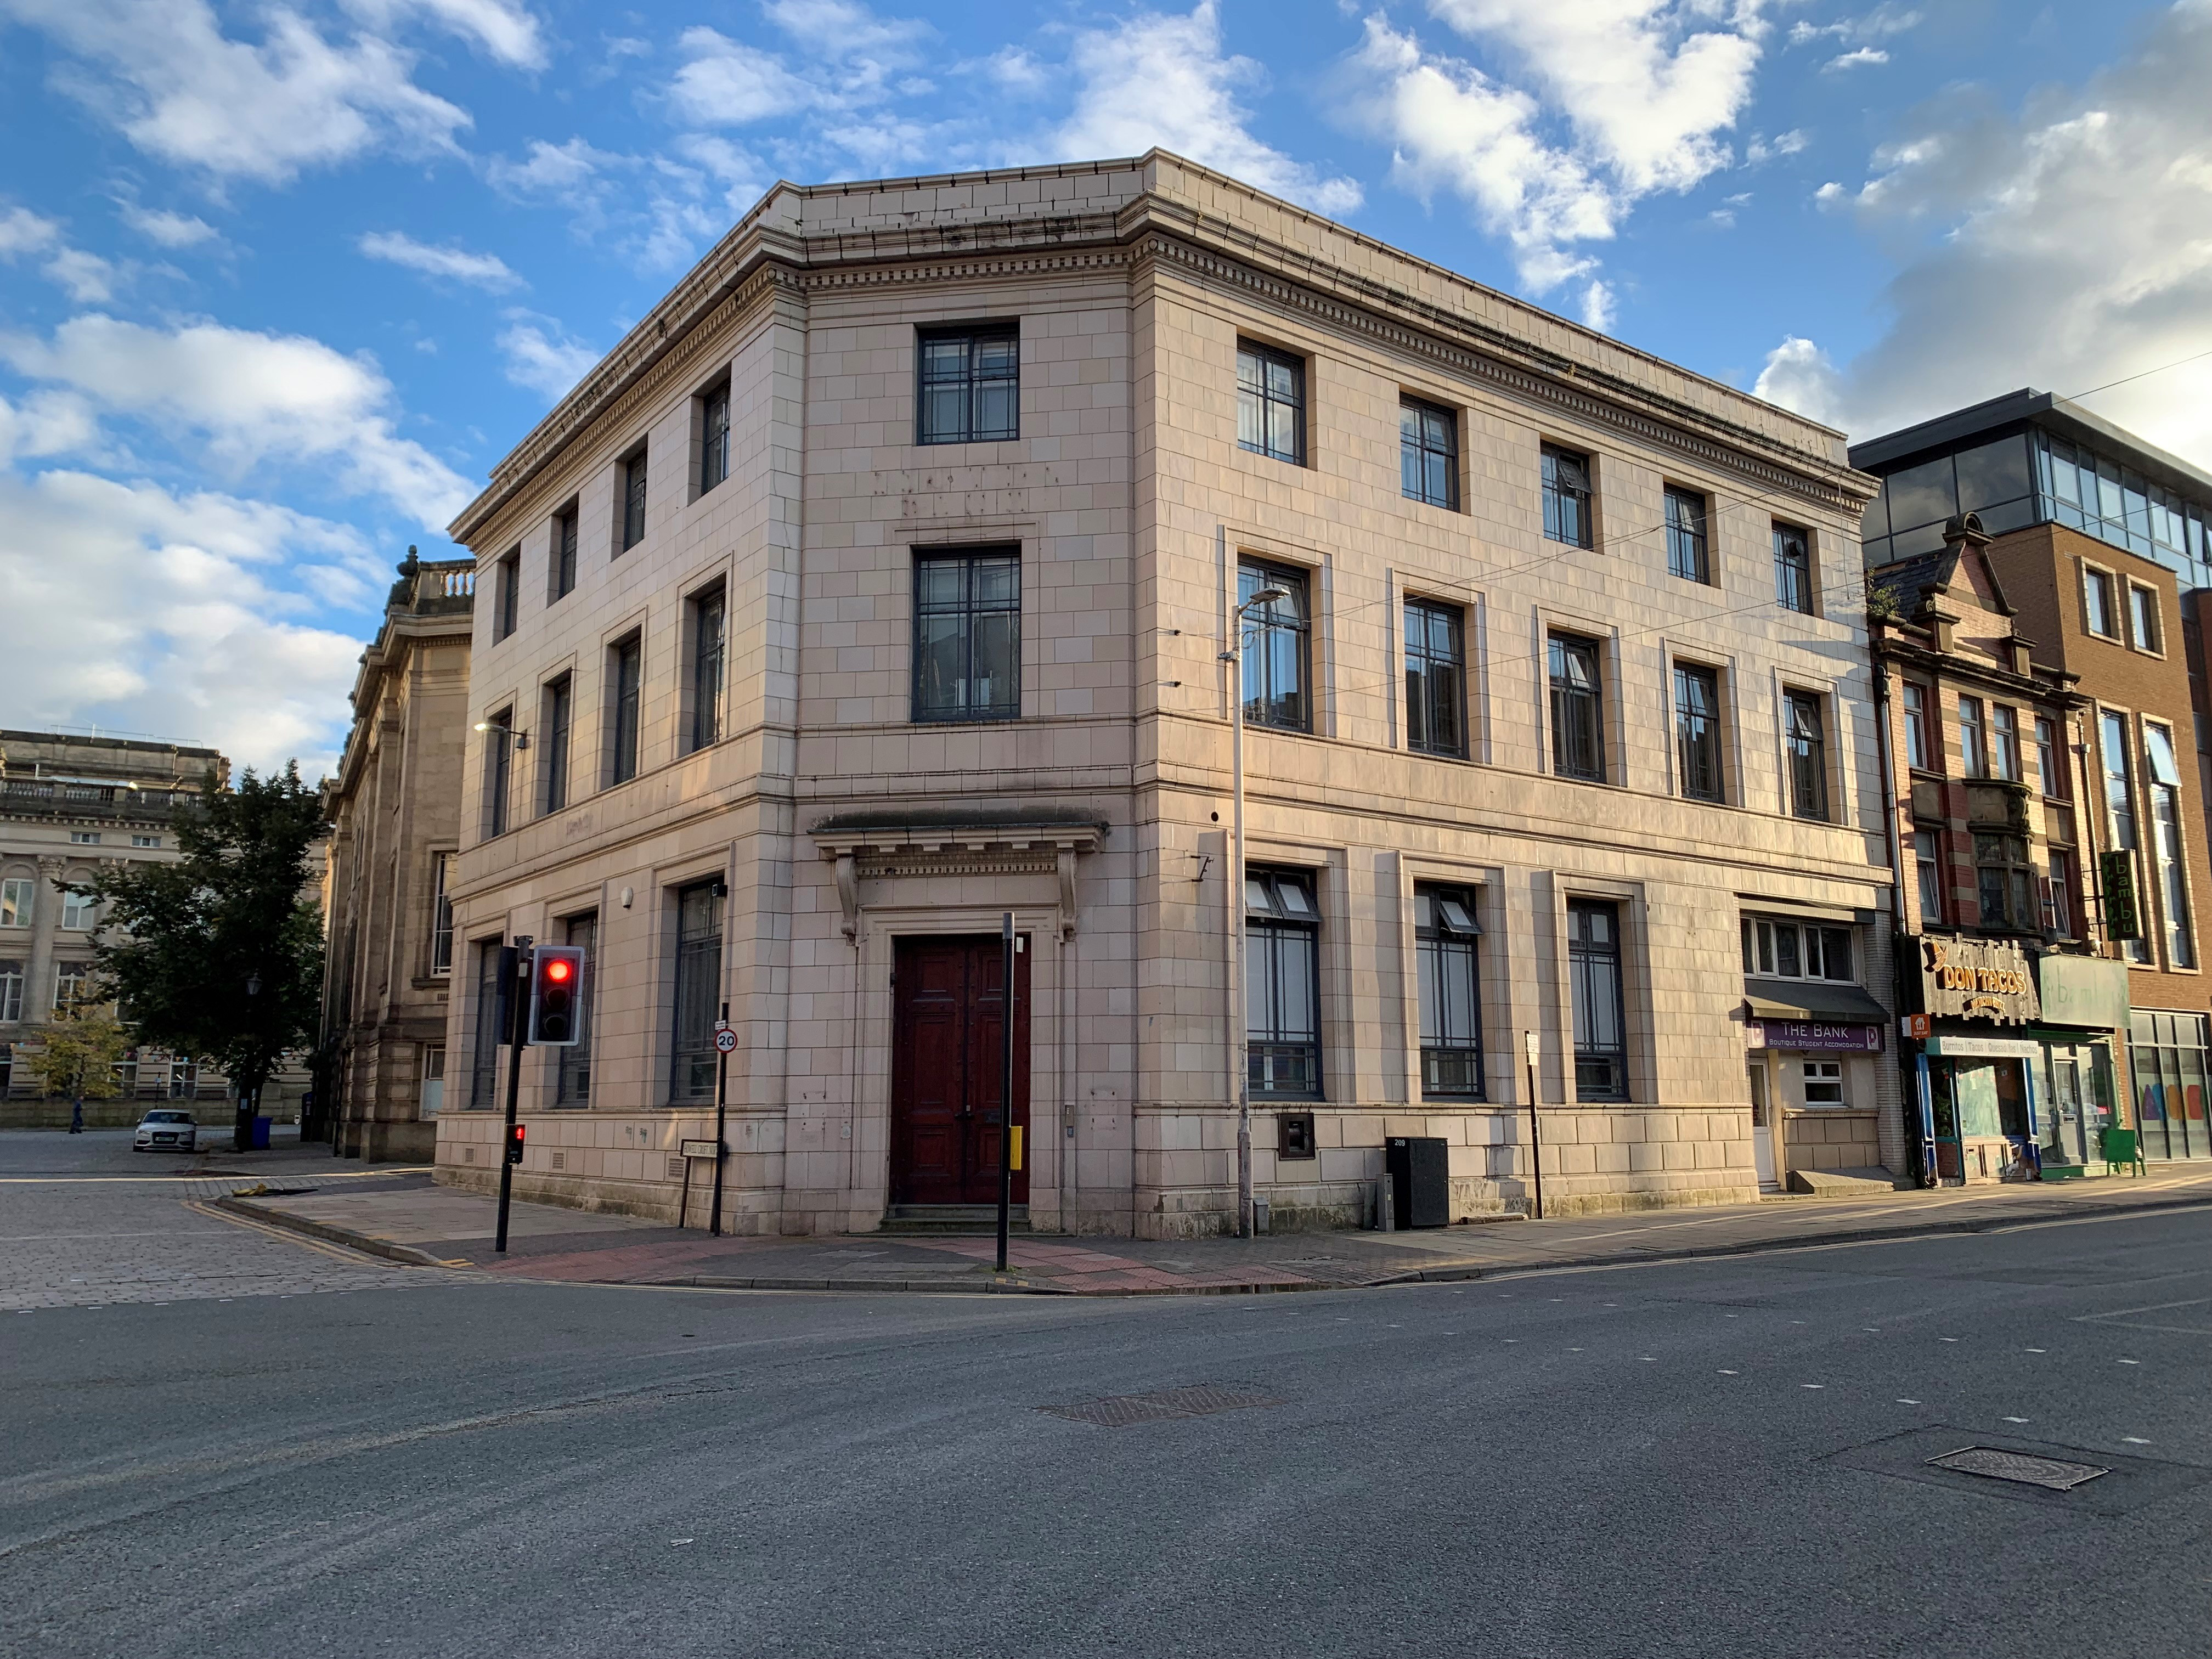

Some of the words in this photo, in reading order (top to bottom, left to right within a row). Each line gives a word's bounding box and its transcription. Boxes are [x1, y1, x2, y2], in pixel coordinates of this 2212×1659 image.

[1943, 964, 1976, 991] DON
[1977, 967, 2027, 995] TACOS
[1781, 1022, 1808, 1037] THE
[1814, 1024, 1849, 1039] BANK
[719, 1035, 735, 1046] 20
[1769, 1039, 1797, 1047] BOUTIQUE
[1942, 1041, 1964, 1052] Burritos
[1968, 1042, 1984, 1052] Tacos
[1988, 1042, 2016, 1053] Quesadilas
[2020, 1044, 2038, 1054] Nachos
